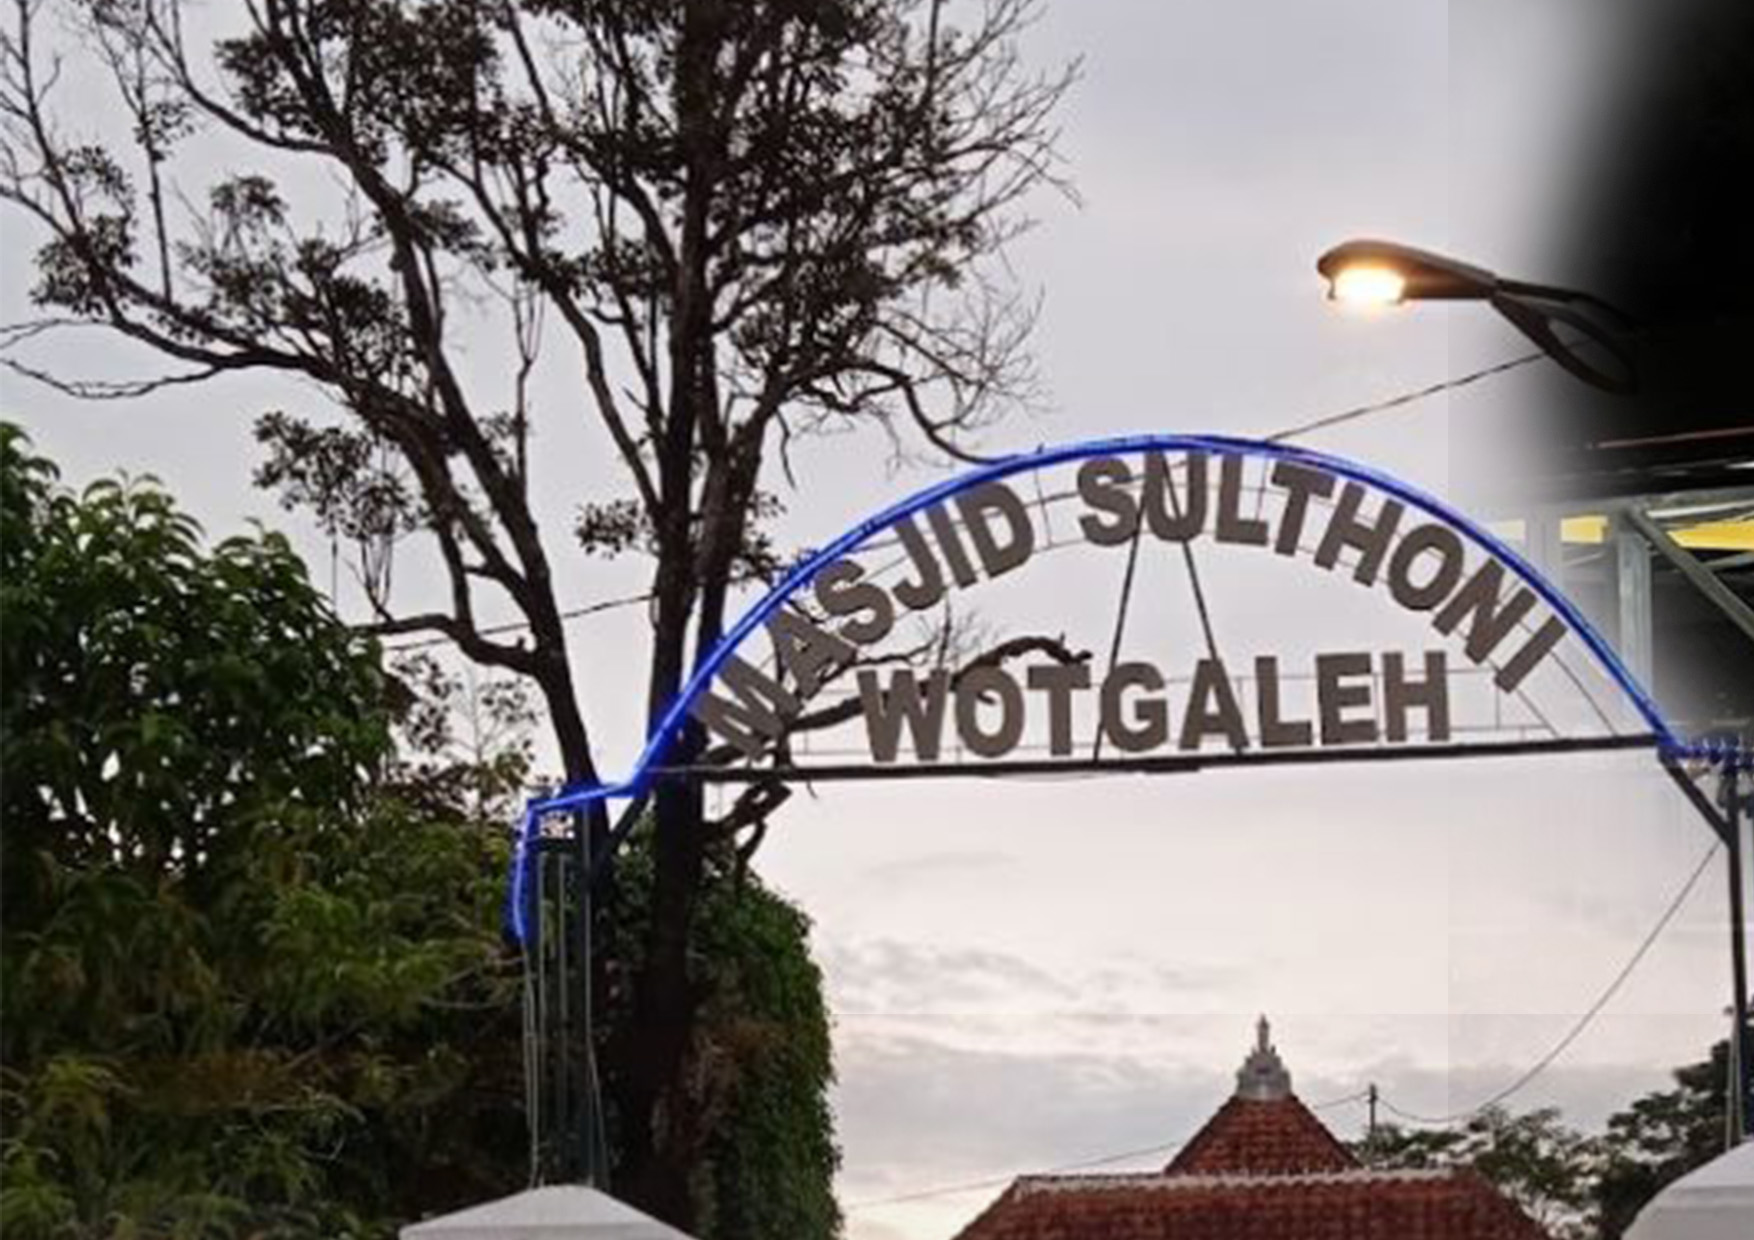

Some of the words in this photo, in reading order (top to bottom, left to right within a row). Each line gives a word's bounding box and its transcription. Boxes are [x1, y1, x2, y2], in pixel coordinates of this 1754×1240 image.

[698, 482, 1035, 760] MASJID
[1077, 450, 1567, 694] SULTHONI
[857, 651, 1450, 762] WOTGALEH
